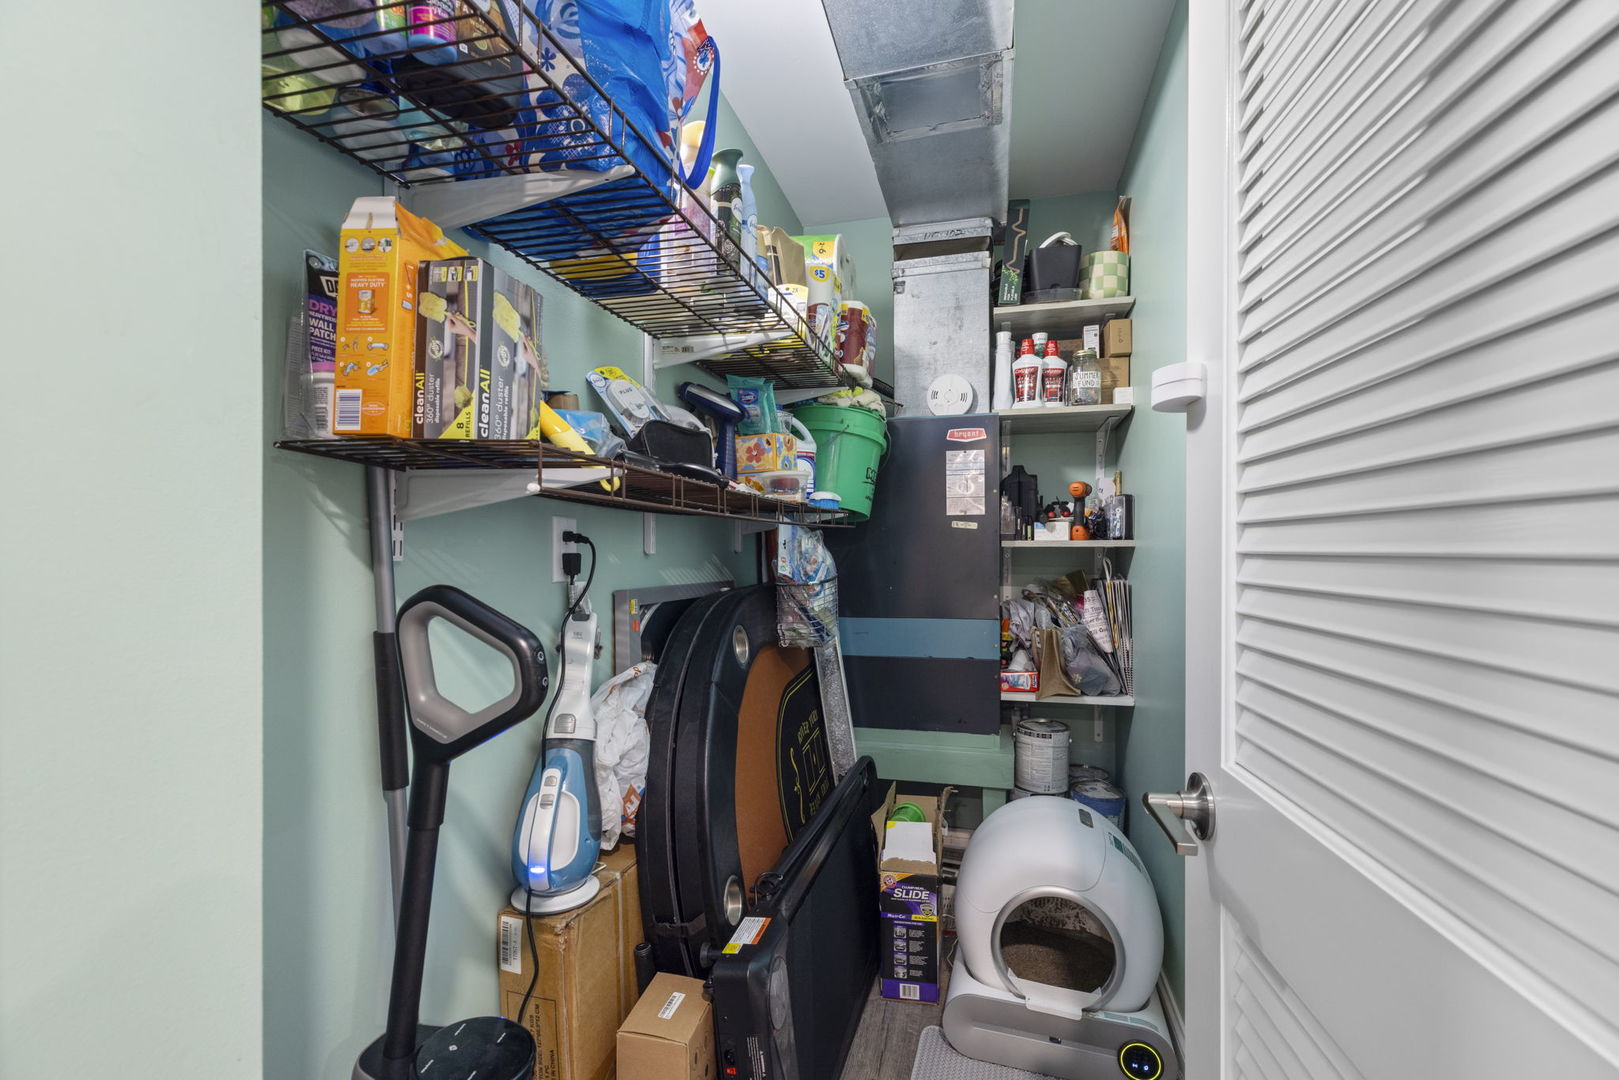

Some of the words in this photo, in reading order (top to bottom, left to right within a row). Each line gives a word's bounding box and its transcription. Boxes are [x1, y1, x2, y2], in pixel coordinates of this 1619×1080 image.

[815, 269, 825, 279] $5
[309, 318, 334, 332] WALL
[309, 327, 336, 341] PATCH
[427, 374, 435, 401] duster
[414, 372, 425, 424] cleanAll
[495, 377, 504, 413] duster
[479, 369, 491, 438] cleanAll
[456, 422, 464, 430] 8
[893, 888, 930, 900] SLIDE
